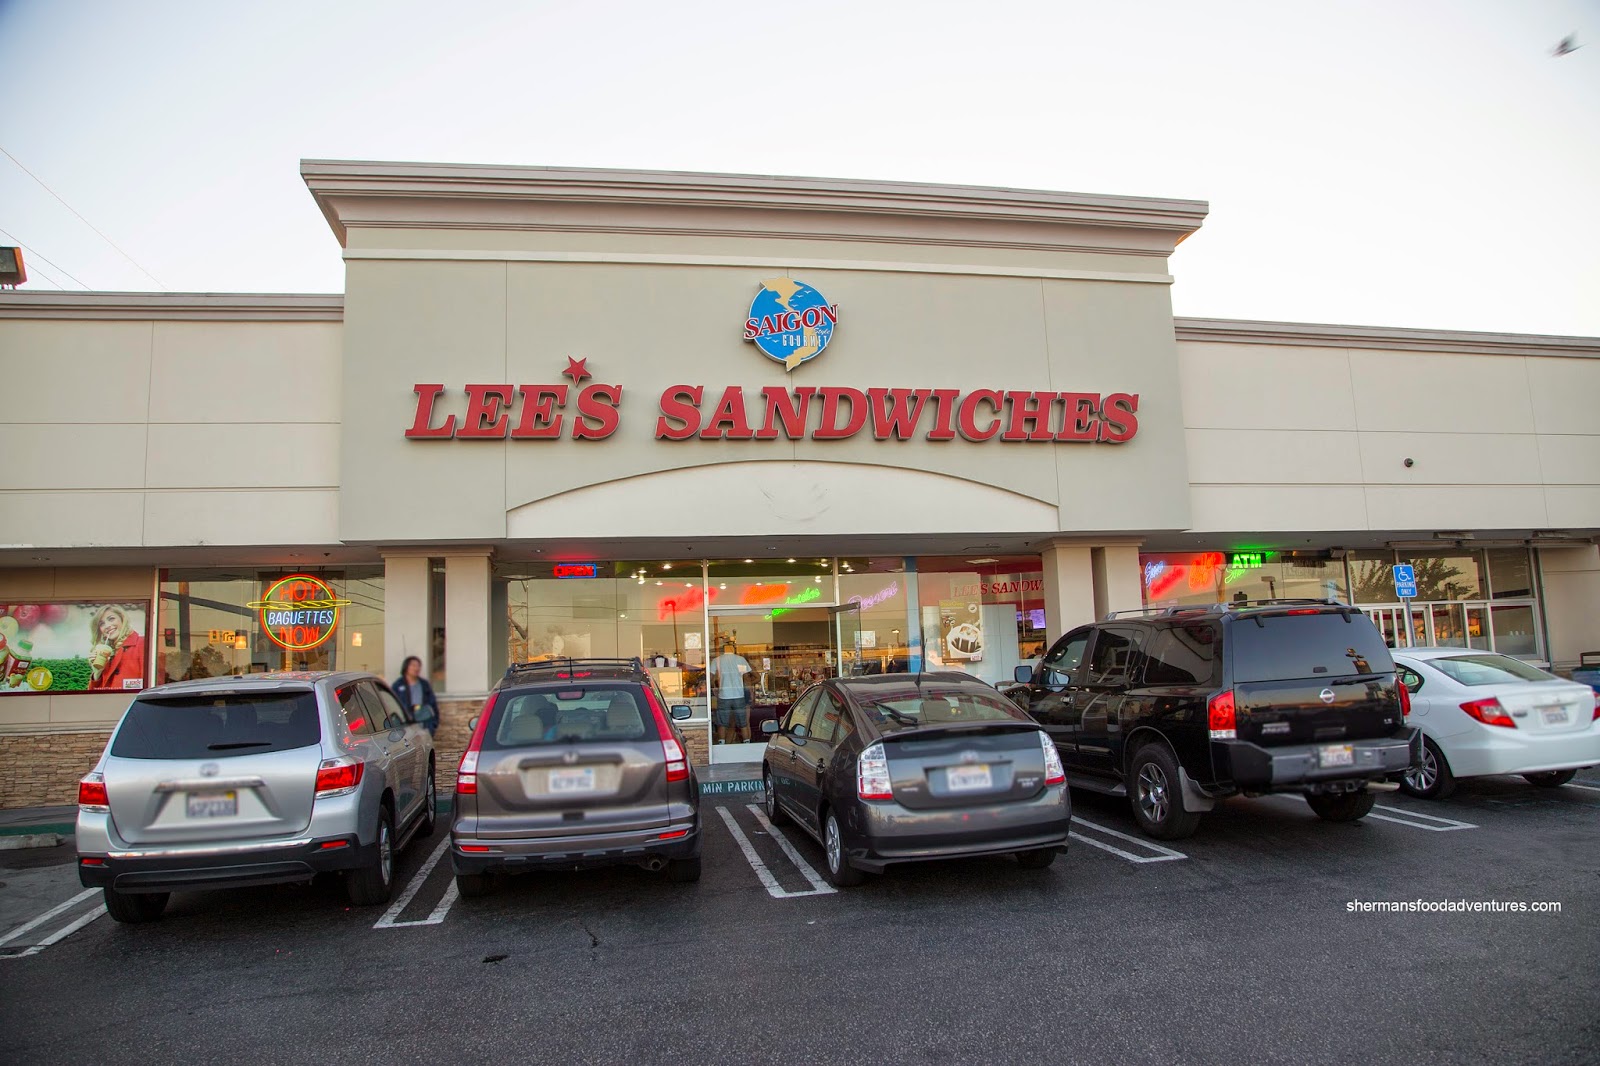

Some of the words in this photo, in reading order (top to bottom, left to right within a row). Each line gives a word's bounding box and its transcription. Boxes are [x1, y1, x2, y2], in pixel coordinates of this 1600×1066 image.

[744, 303, 840, 340] SAIGON
[782, 335, 828, 347] GOURMET
[404, 357, 624, 441] LEE'S
[654, 383, 1140, 443] SANDWICHES
[1232, 553, 1262, 569] ATM
[553, 565, 595, 577] OPEN
[279, 580, 320, 601] HOT
[991, 579, 1044, 595] SANDW
[267, 610, 334, 626] BAGUETTES
[279, 625, 321, 646] NOW
[32, 671, 46, 686] #1
[703, 783, 722, 794] MIN
